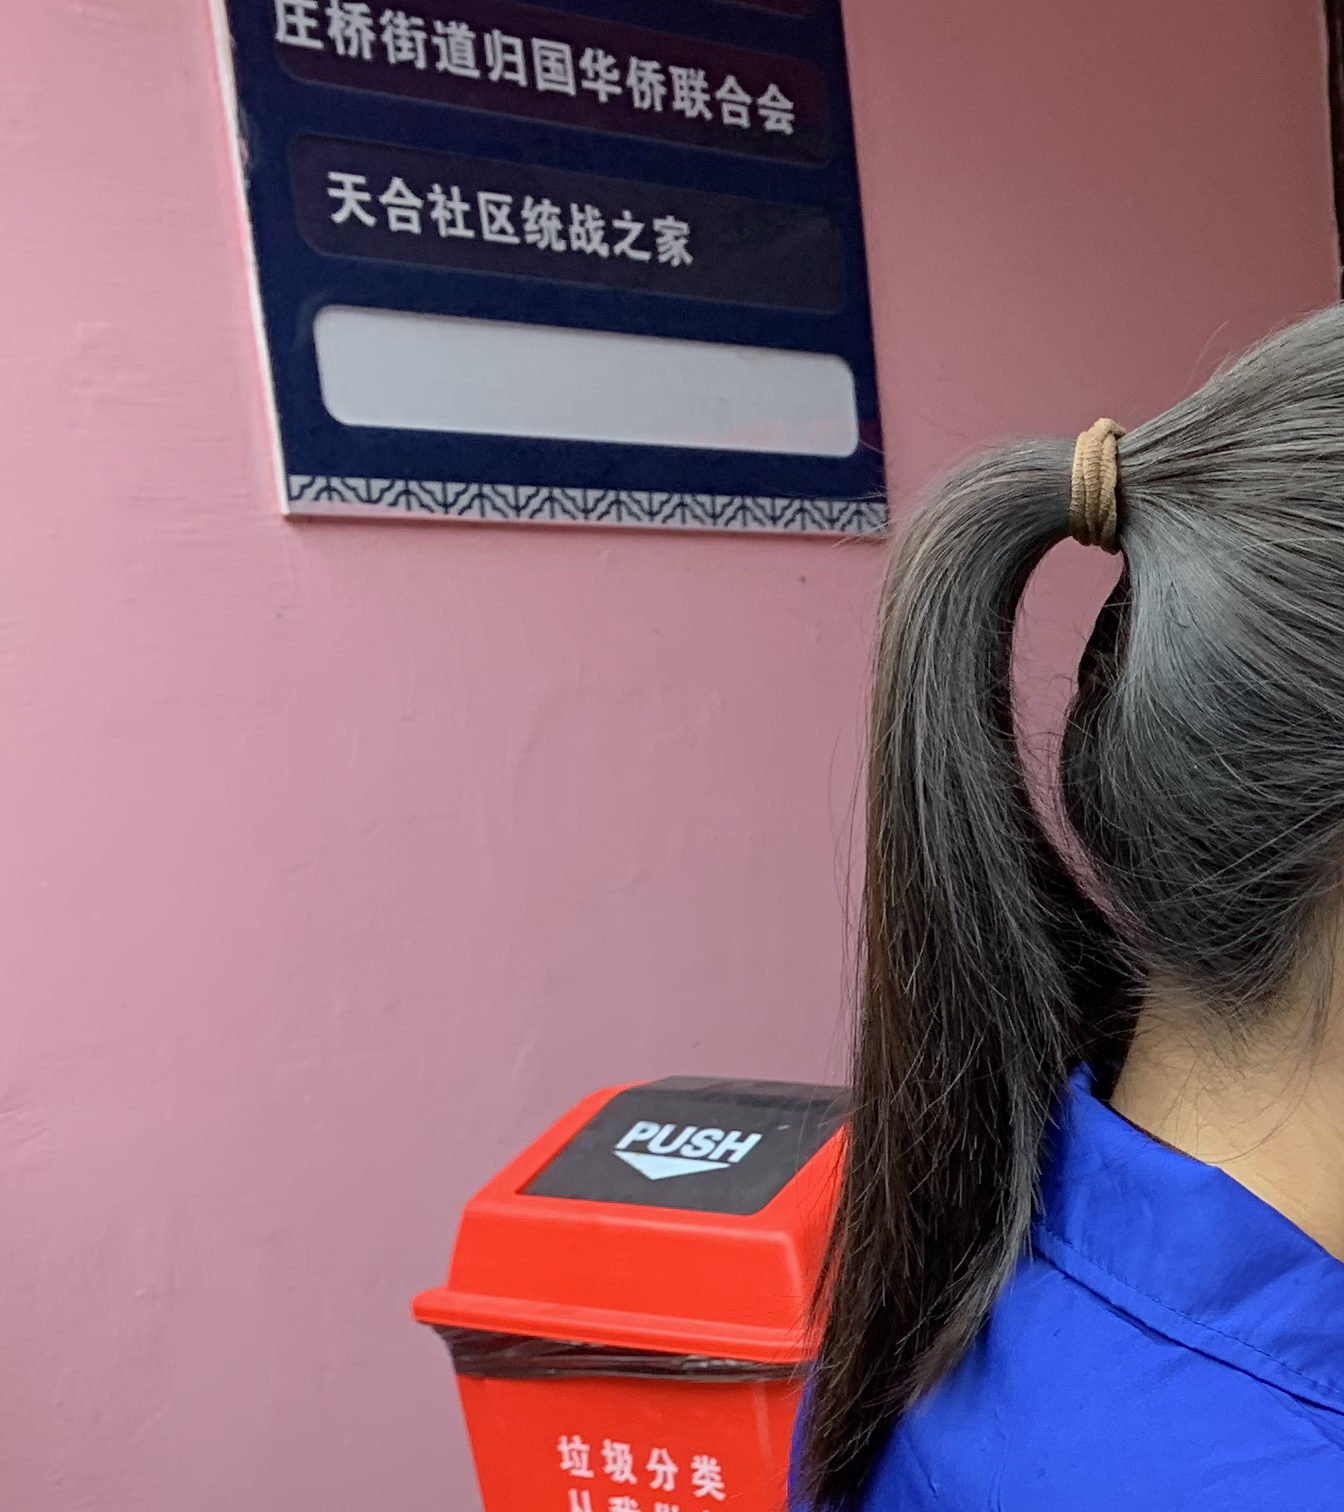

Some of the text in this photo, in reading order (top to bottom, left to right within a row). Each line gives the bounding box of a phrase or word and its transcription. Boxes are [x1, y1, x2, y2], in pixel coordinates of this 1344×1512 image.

[274, 0, 797, 136] 庄桥街道归国华侨联合会
[326, 169, 694, 267] 天合社区统战之家
[615, 1120, 762, 1163] PUSH
[556, 1435, 727, 1502] 垃圾分类
